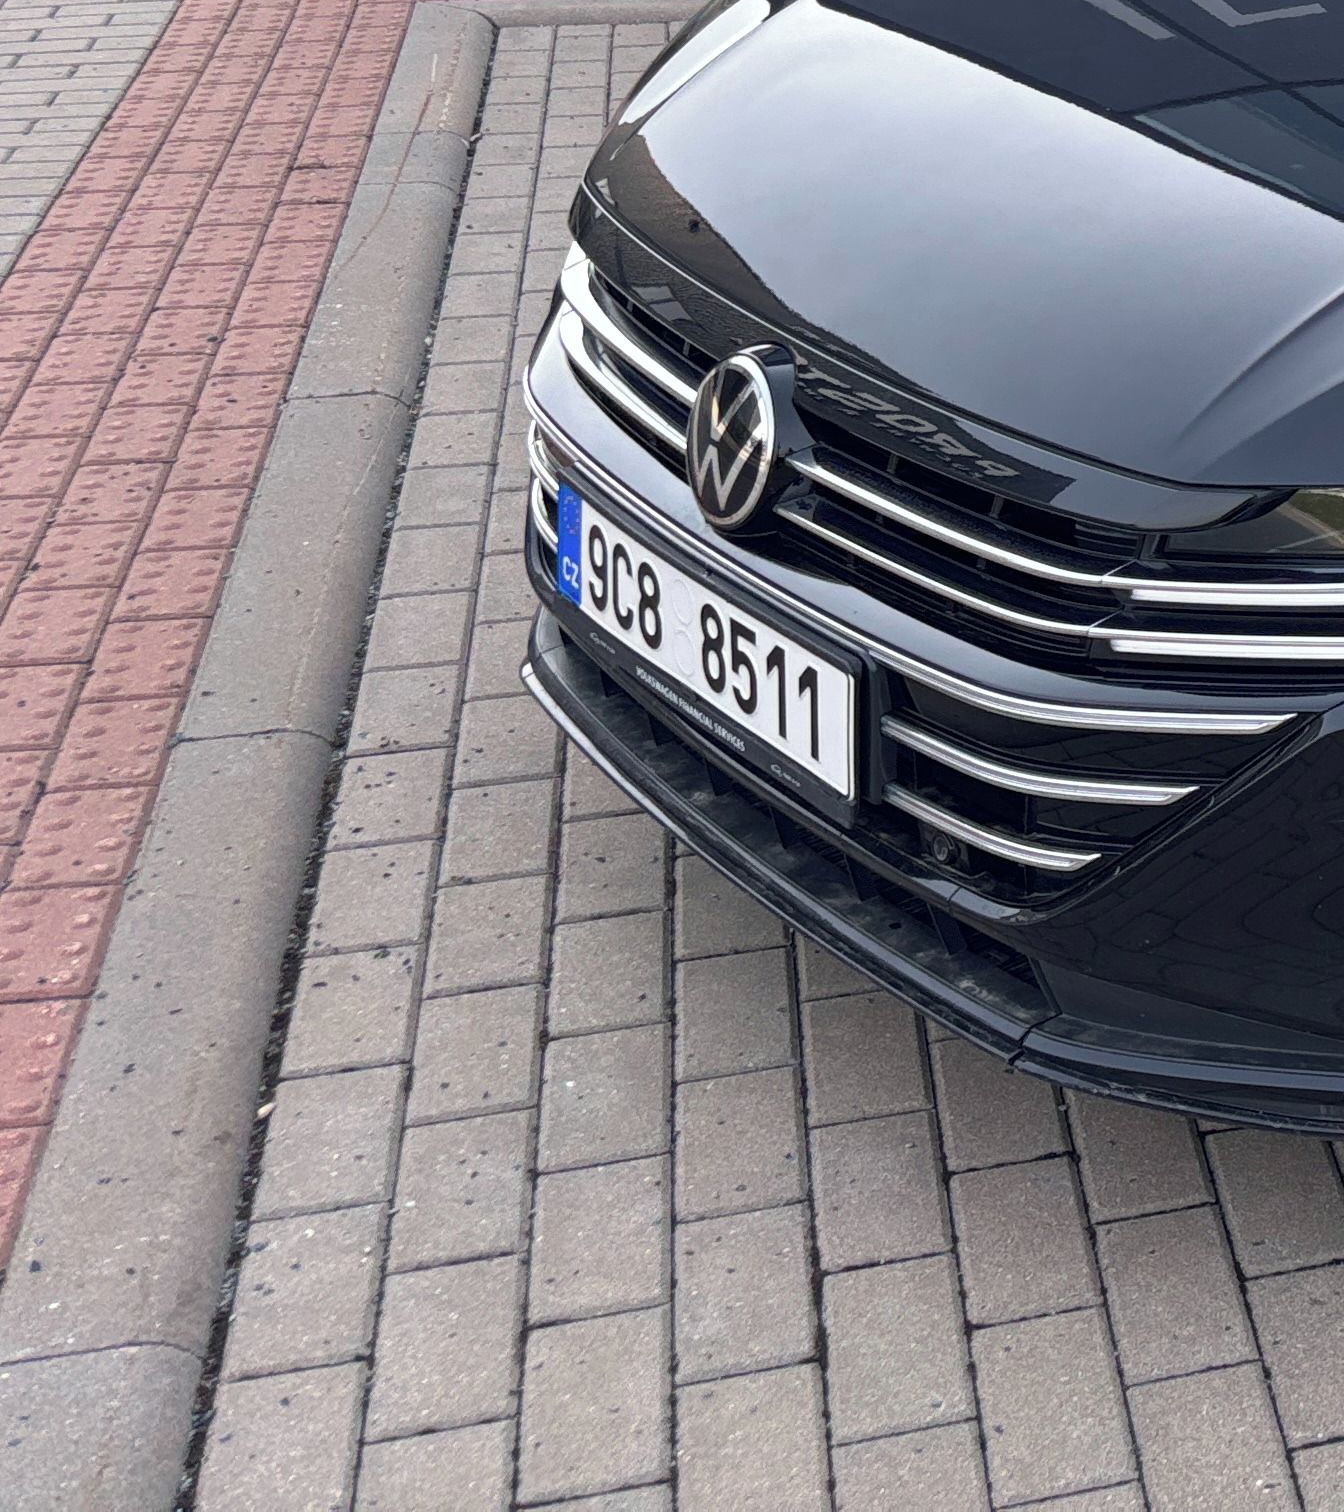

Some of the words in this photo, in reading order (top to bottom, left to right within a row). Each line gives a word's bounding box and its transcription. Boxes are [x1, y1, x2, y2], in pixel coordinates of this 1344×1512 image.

[562, 556, 579, 588] CZ
[588, 525, 662, 649] 9C8
[700, 603, 820, 762] 8511
[635, 665, 678, 706] VOLKSWAGEN
[678, 697, 714, 730] FINANCIAL
[713, 722, 746, 751] SERVICES
